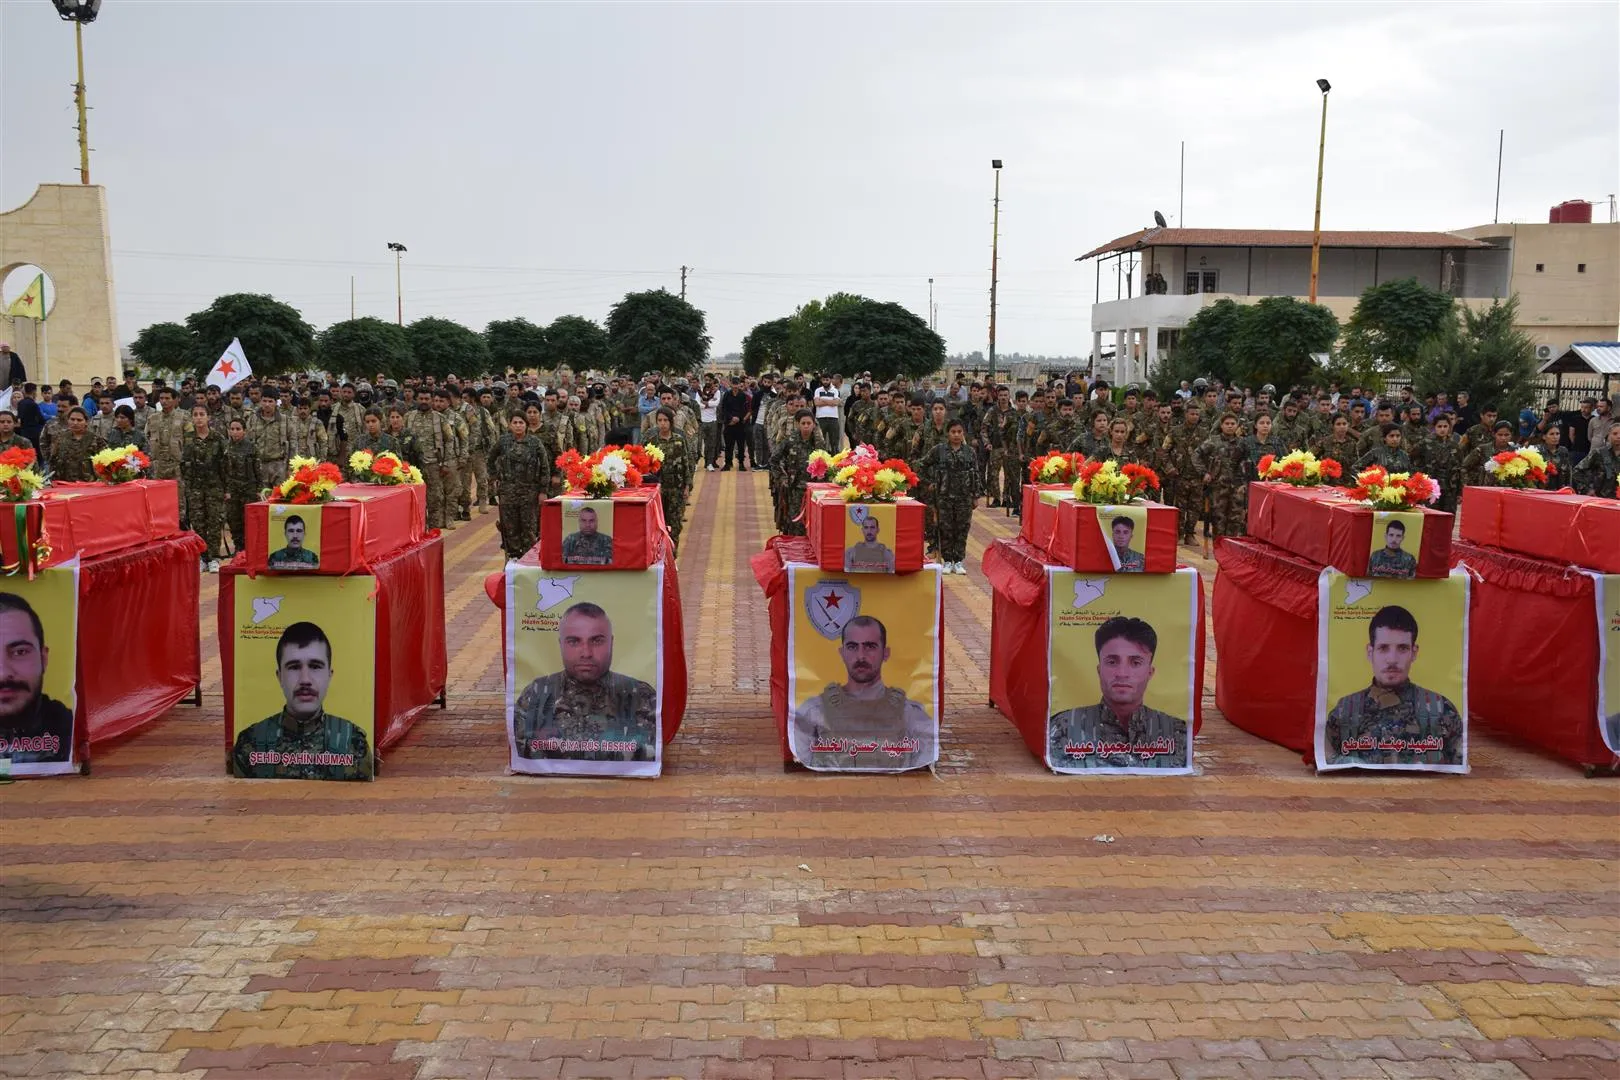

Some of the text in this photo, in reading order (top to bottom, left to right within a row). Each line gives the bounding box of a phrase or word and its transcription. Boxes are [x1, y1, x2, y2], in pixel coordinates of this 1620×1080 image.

[9, 731, 60, 754] ARGÊŞ
[810, 735, 920, 757] الشهيد حسن الخلف
[1064, 735, 1175, 759] الشهيد محمود عبيد
[1378, 736, 1406, 752] مهند
[1407, 735, 1444, 753] الشهيد
